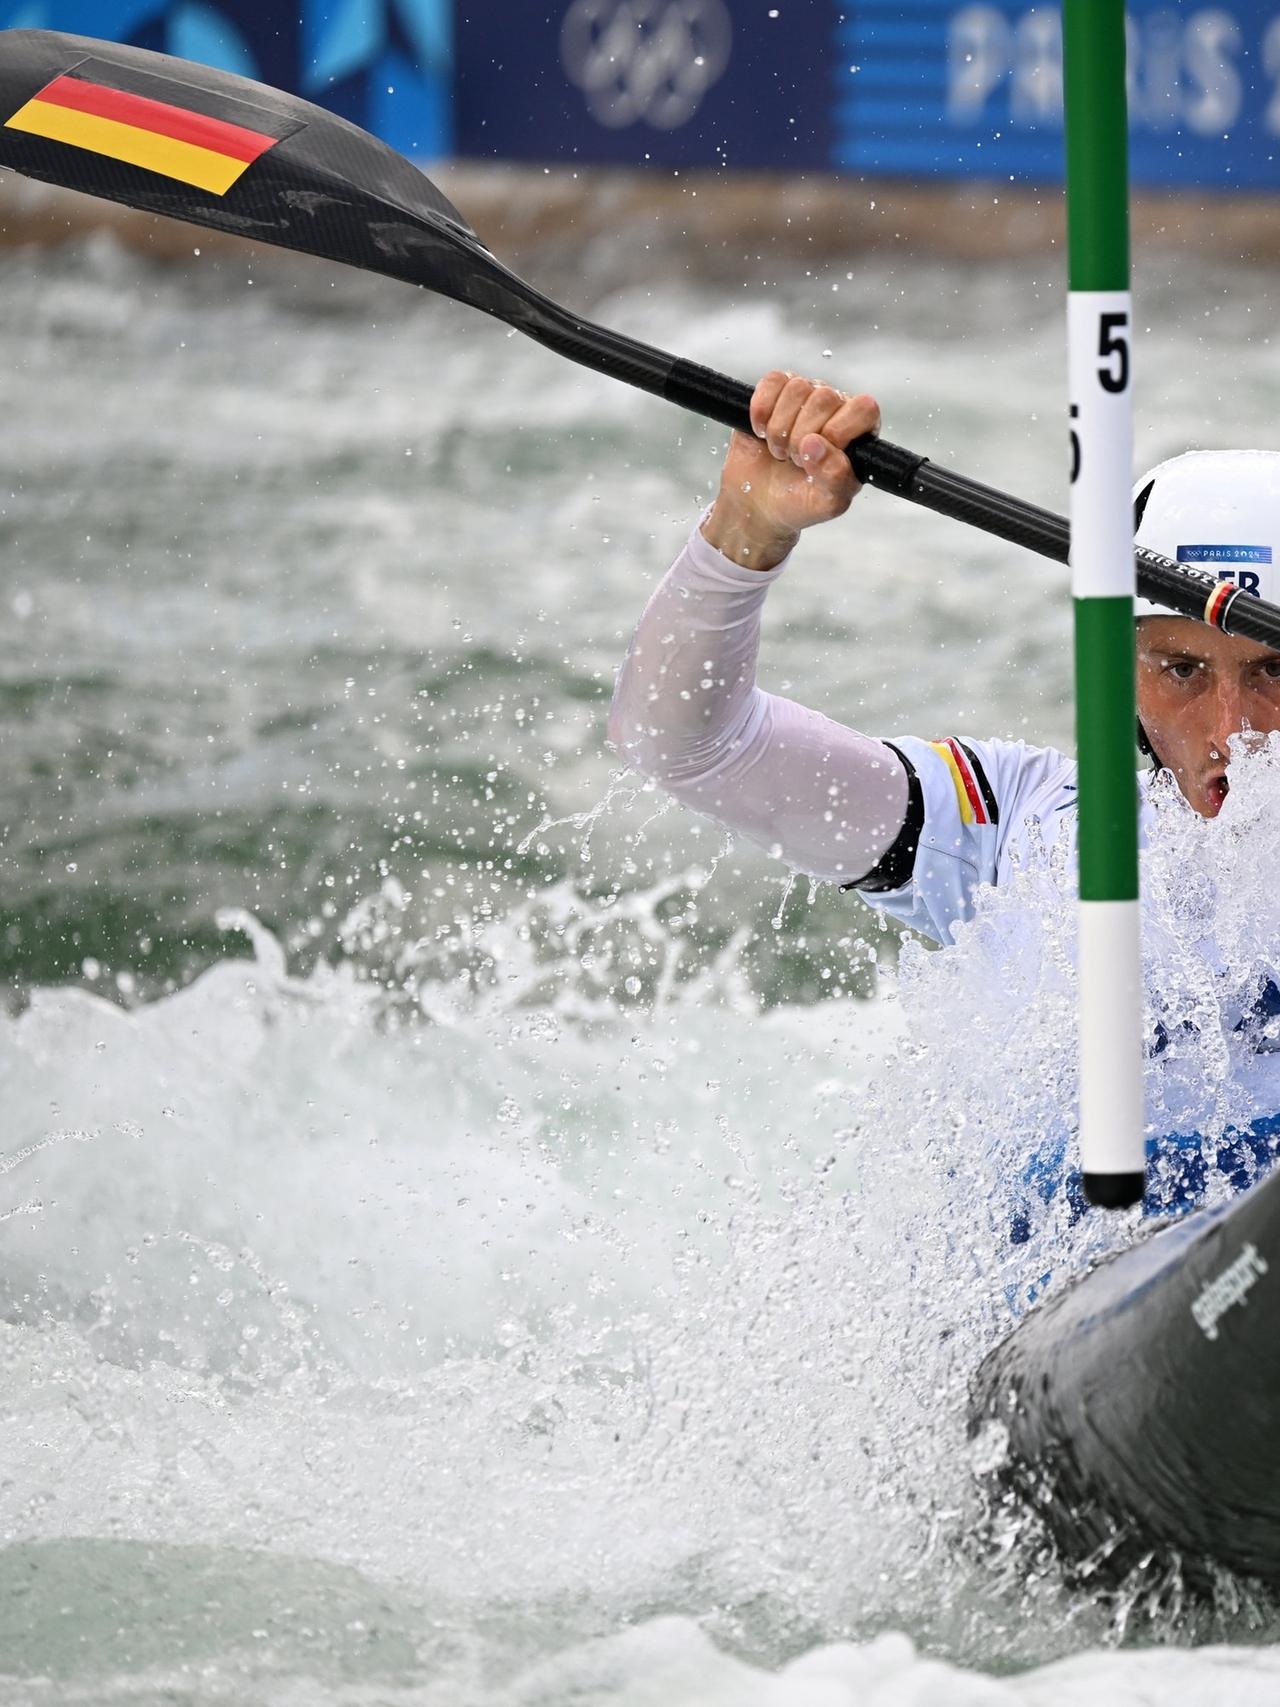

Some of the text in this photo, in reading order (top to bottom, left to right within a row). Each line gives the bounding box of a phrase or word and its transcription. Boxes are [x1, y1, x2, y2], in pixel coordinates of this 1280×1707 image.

[945, 5, 1242, 134] PAIS
[1097, 312, 1129, 394] 5
[1135, 547, 1173, 567] ARIS
[1234, 550, 1260, 558] 2024
